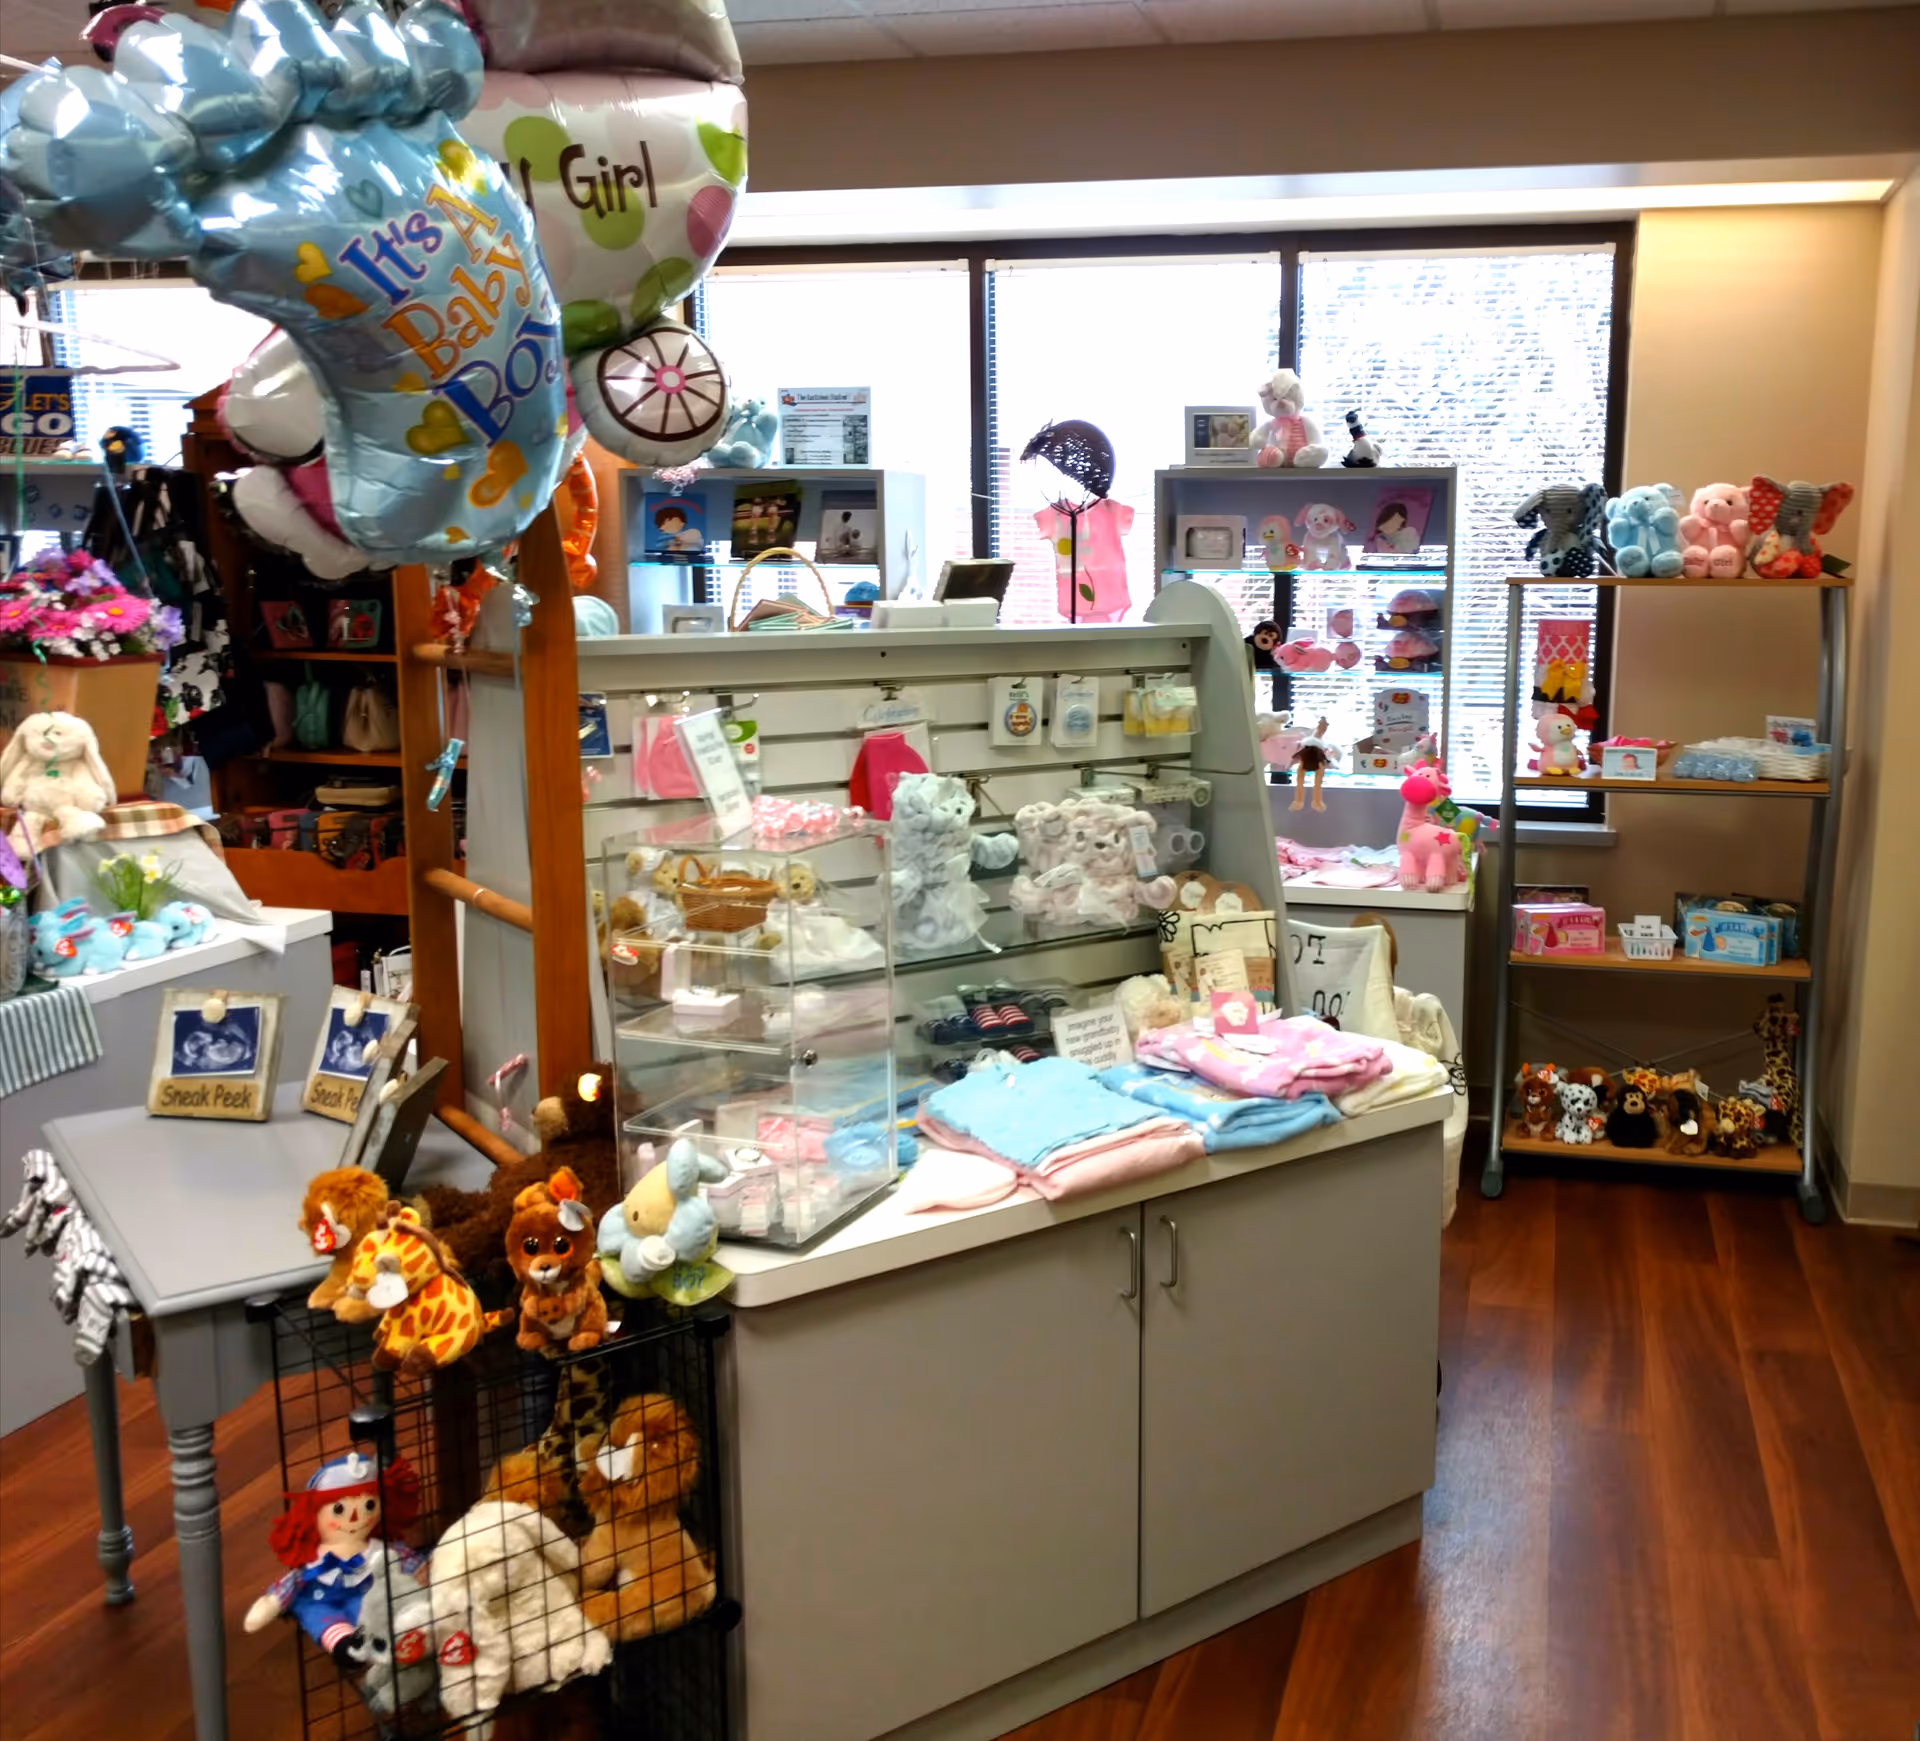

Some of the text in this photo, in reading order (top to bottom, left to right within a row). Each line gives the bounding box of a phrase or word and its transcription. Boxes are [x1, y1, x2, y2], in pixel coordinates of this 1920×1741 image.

[559, 140, 658, 219] Girl
[338, 212, 443, 306] It's
[426, 184, 498, 264] A
[380, 233, 532, 381] Baby
[1, 412, 73, 436] GO
[161, 1082, 252, 1109] Sneak Peek
[312, 1082, 345, 1107] Sneak
